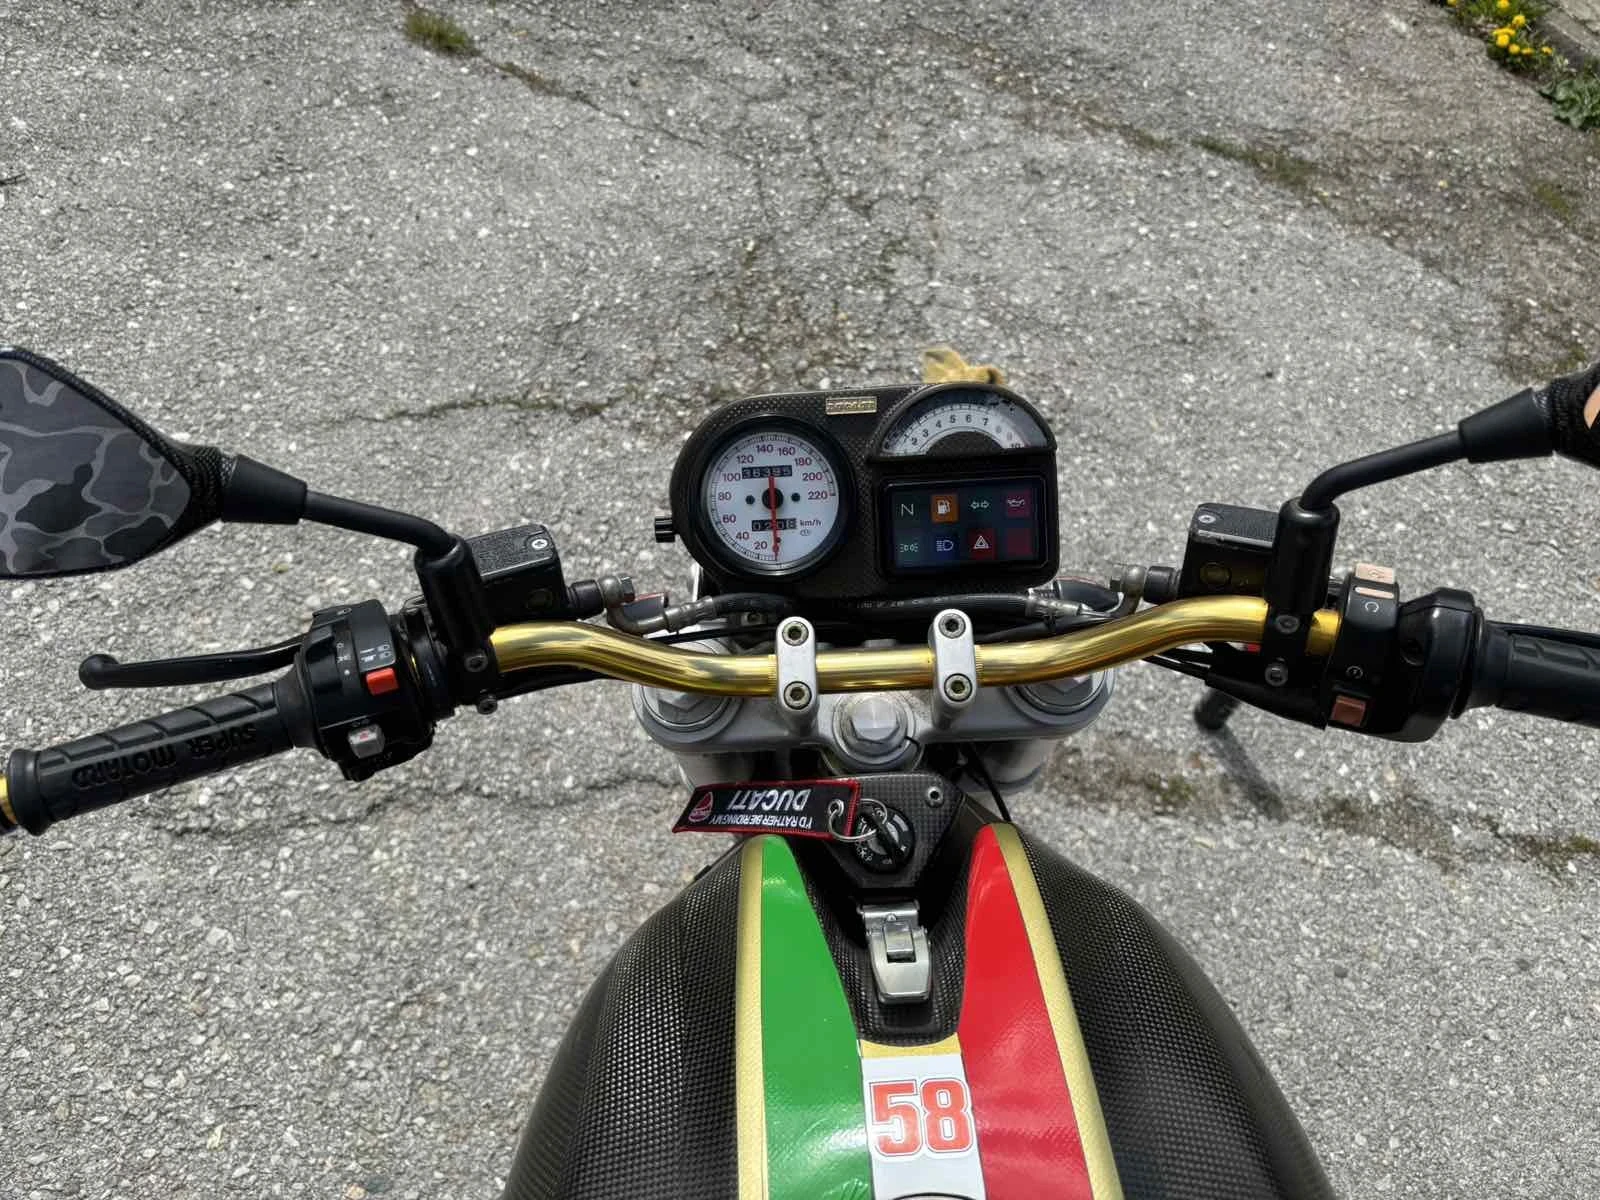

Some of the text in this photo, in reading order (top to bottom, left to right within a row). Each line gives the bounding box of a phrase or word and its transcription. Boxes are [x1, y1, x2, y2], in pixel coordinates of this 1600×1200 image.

[950, 415, 956, 424] 5
[965, 415, 972, 423] 6
[983, 417, 989, 426] 7
[936, 420, 942, 428] 4
[922, 429, 929, 438] 3
[911, 437, 918, 446] 2
[755, 444, 774, 454] 140
[778, 446, 796, 456] 160
[737, 455, 754, 464] 120
[795, 457, 812, 466] 180
[723, 473, 741, 482] 100
[802, 472, 823, 481] 200
[718, 491, 732, 501] 80
[808, 491, 828, 500] 220
[900, 503, 914, 516] N
[722, 514, 737, 523] 60
[799, 519, 822, 528] km/h
[736, 531, 749, 540] 40
[754, 541, 768, 550] 20
[727, 789, 811, 811] DUCATI
[763, 814, 798, 827] RATHER
[868, 1077, 973, 1157] 58
